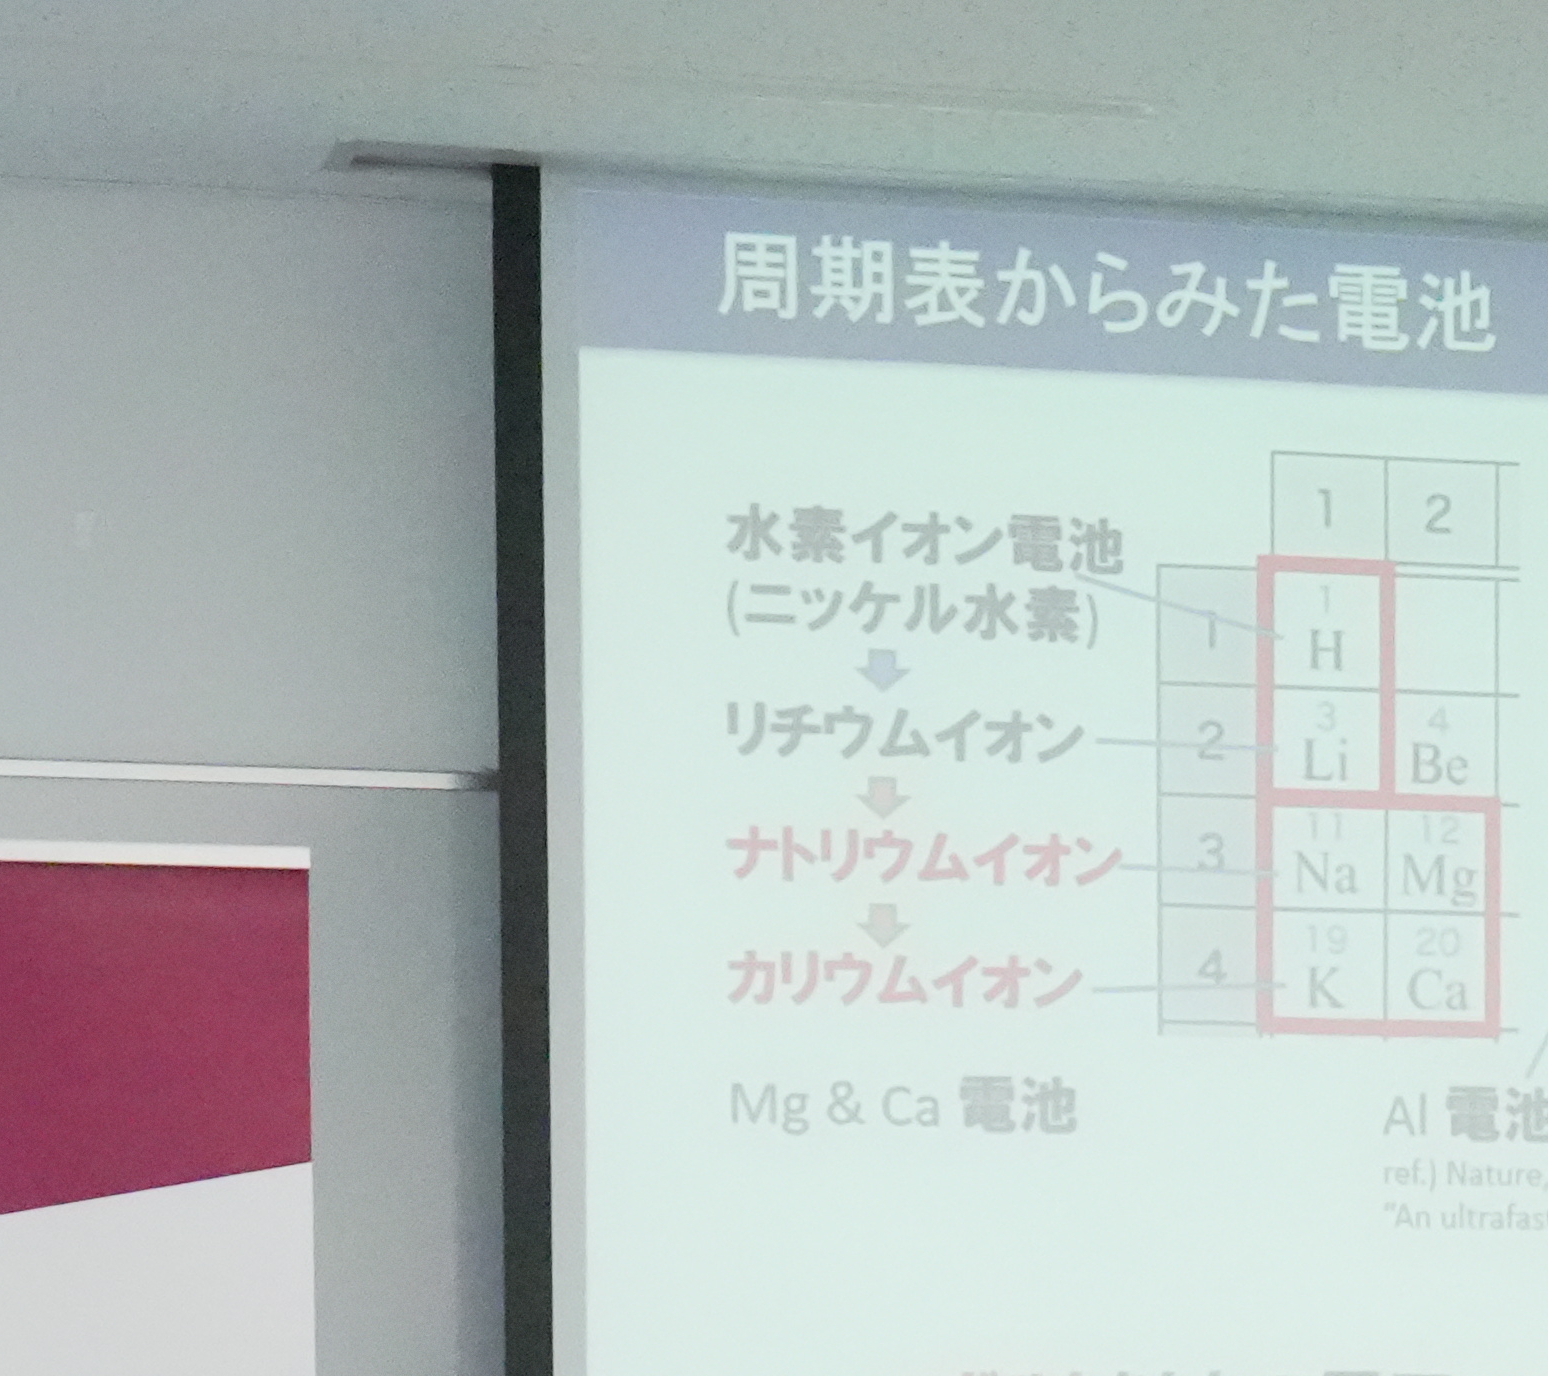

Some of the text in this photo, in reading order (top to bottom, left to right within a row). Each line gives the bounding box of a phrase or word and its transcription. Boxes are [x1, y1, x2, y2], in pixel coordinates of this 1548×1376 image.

[718, 231, 1496, 353] 周期表からみた電池
[1318, 487, 1332, 529] 1
[1425, 493, 1452, 534] 2
[726, 503, 1124, 574] 水素イオン電池
[728, 579, 1098, 649] (ニッケル水素)
[1309, 629, 1345, 671] H
[726, 701, 1084, 763] リチウムイオン
[1198, 720, 1224, 761] 2
[1316, 701, 1337, 732] 3
[1427, 706, 1450, 735] 4
[1302, 737, 1350, 782] Li
[1411, 742, 1468, 786] Be
[1198, 832, 1225, 870] 3
[1308, 812, 1343, 841] 11
[1421, 814, 1461, 845] 12
[726, 825, 1122, 886] ナトリウムイオン
[1293, 851, 1359, 895] Na
[1402, 853, 1478, 907] Mg
[1307, 924, 1348, 955] 19
[1415, 927, 1462, 958] 20
[727, 950, 1083, 1008] カリウムイオン
[1198, 949, 1227, 985] 4
[1307, 966, 1345, 1009] K
[1407, 967, 1468, 1010] Ca
[729, 1075, 1078, 1135] Mg & Ca 電池
[1383, 1094, 1427, 1137] Al
[1383, 1158, 1436, 1192] ref.)
